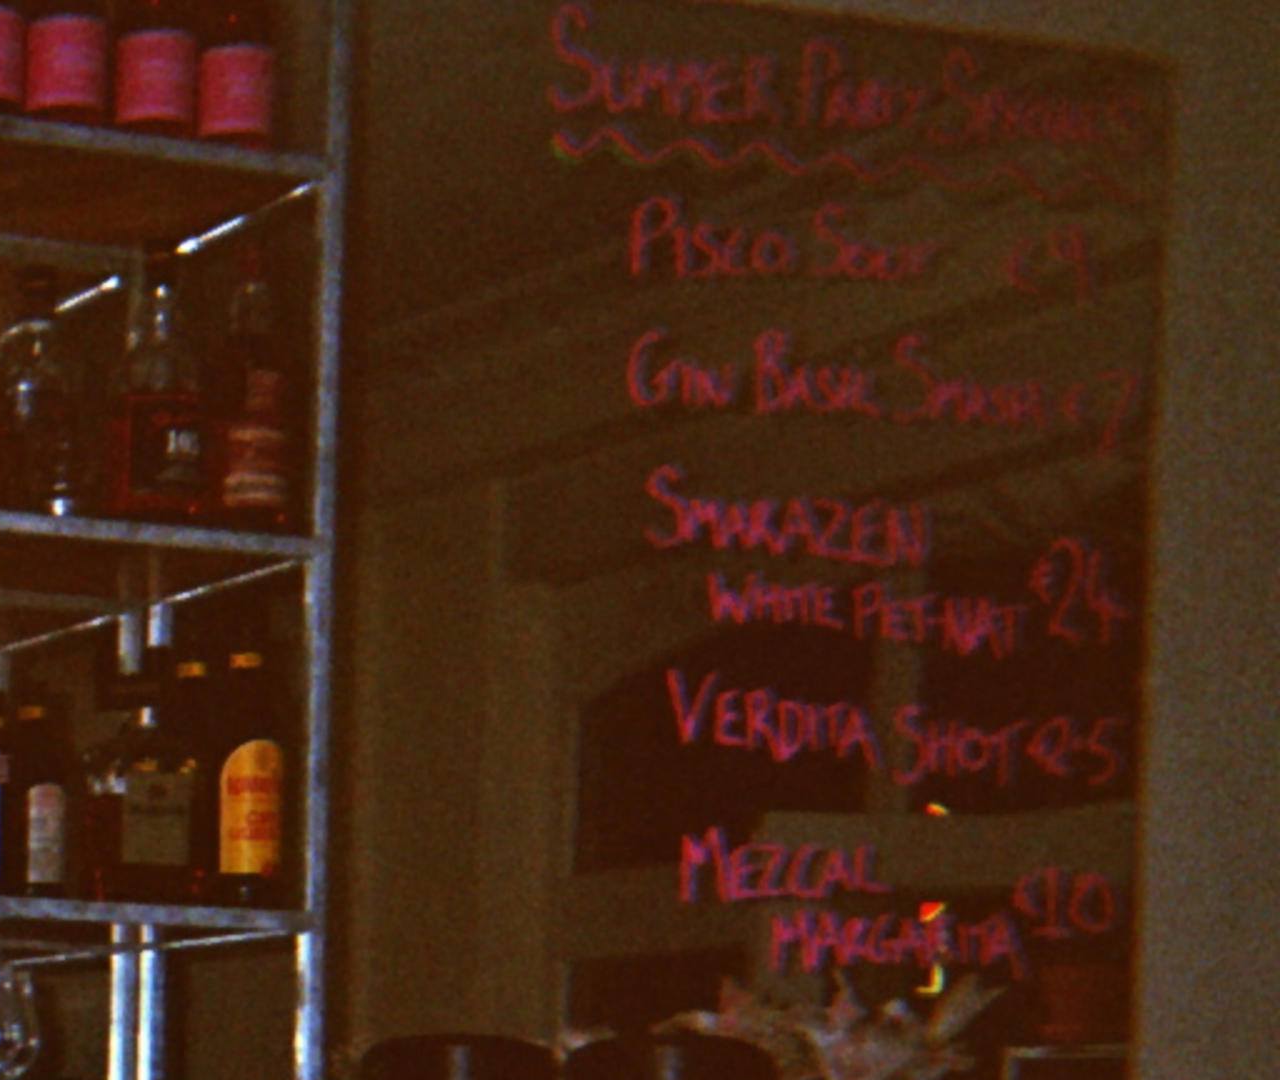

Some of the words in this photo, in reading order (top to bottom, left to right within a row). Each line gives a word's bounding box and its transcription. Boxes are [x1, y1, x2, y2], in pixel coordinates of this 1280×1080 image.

[629, 197, 793, 278] PISCO
[627, 331, 734, 406] GIN
[707, 571, 843, 631] WHITE
[664, 668, 881, 773] VERDITA
[679, 825, 894, 903] MEZCAL
